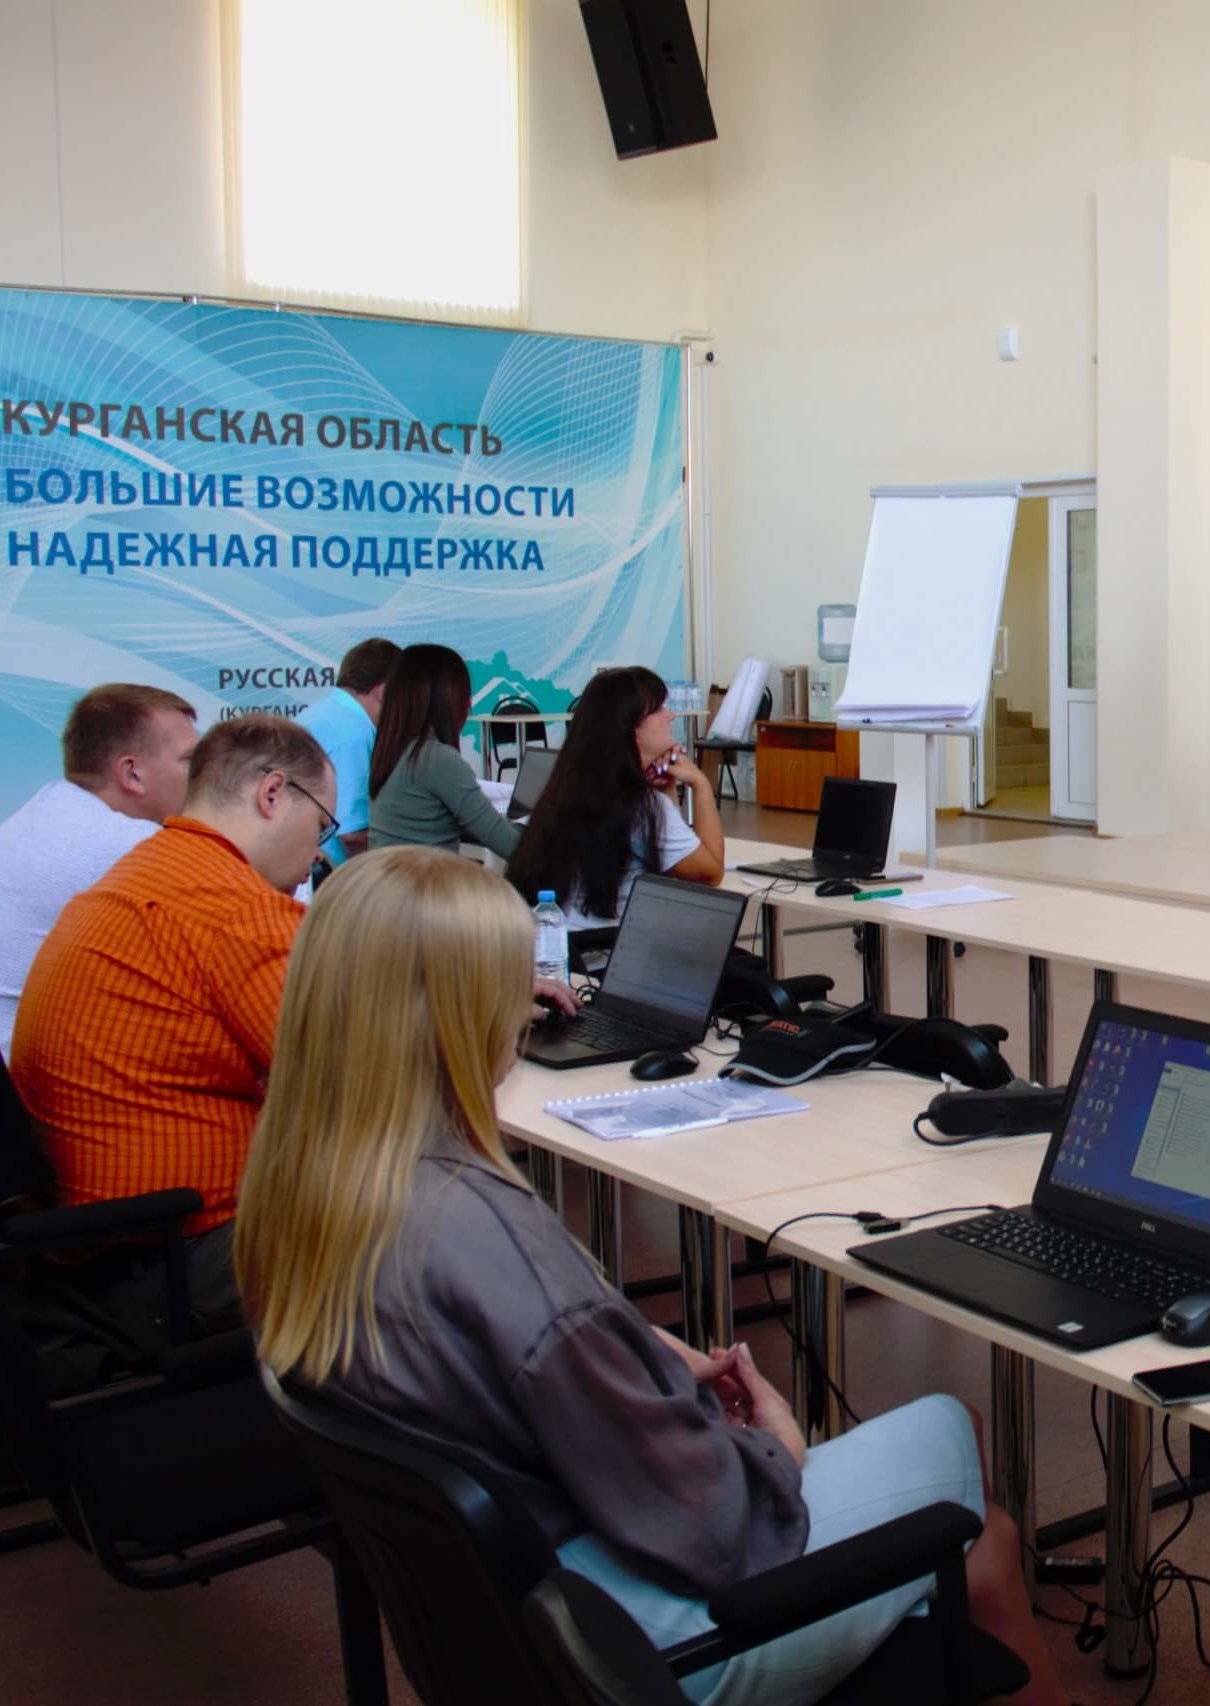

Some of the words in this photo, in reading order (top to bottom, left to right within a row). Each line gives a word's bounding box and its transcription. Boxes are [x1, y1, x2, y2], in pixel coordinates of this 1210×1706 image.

[2, 399, 304, 447] КУРГАНСКАЯ
[316, 414, 503, 457] ОБЛАСТЬ
[5, 468, 245, 508] БОЛЬШИЕ
[256, 475, 575, 518] ВОЗМОЖНОСТИ
[8, 531, 279, 575] НАДЕЖНАЯ
[291, 535, 545, 577] ПОДДЕРЖКА
[218, 667, 335, 689] РУССКАЯ
